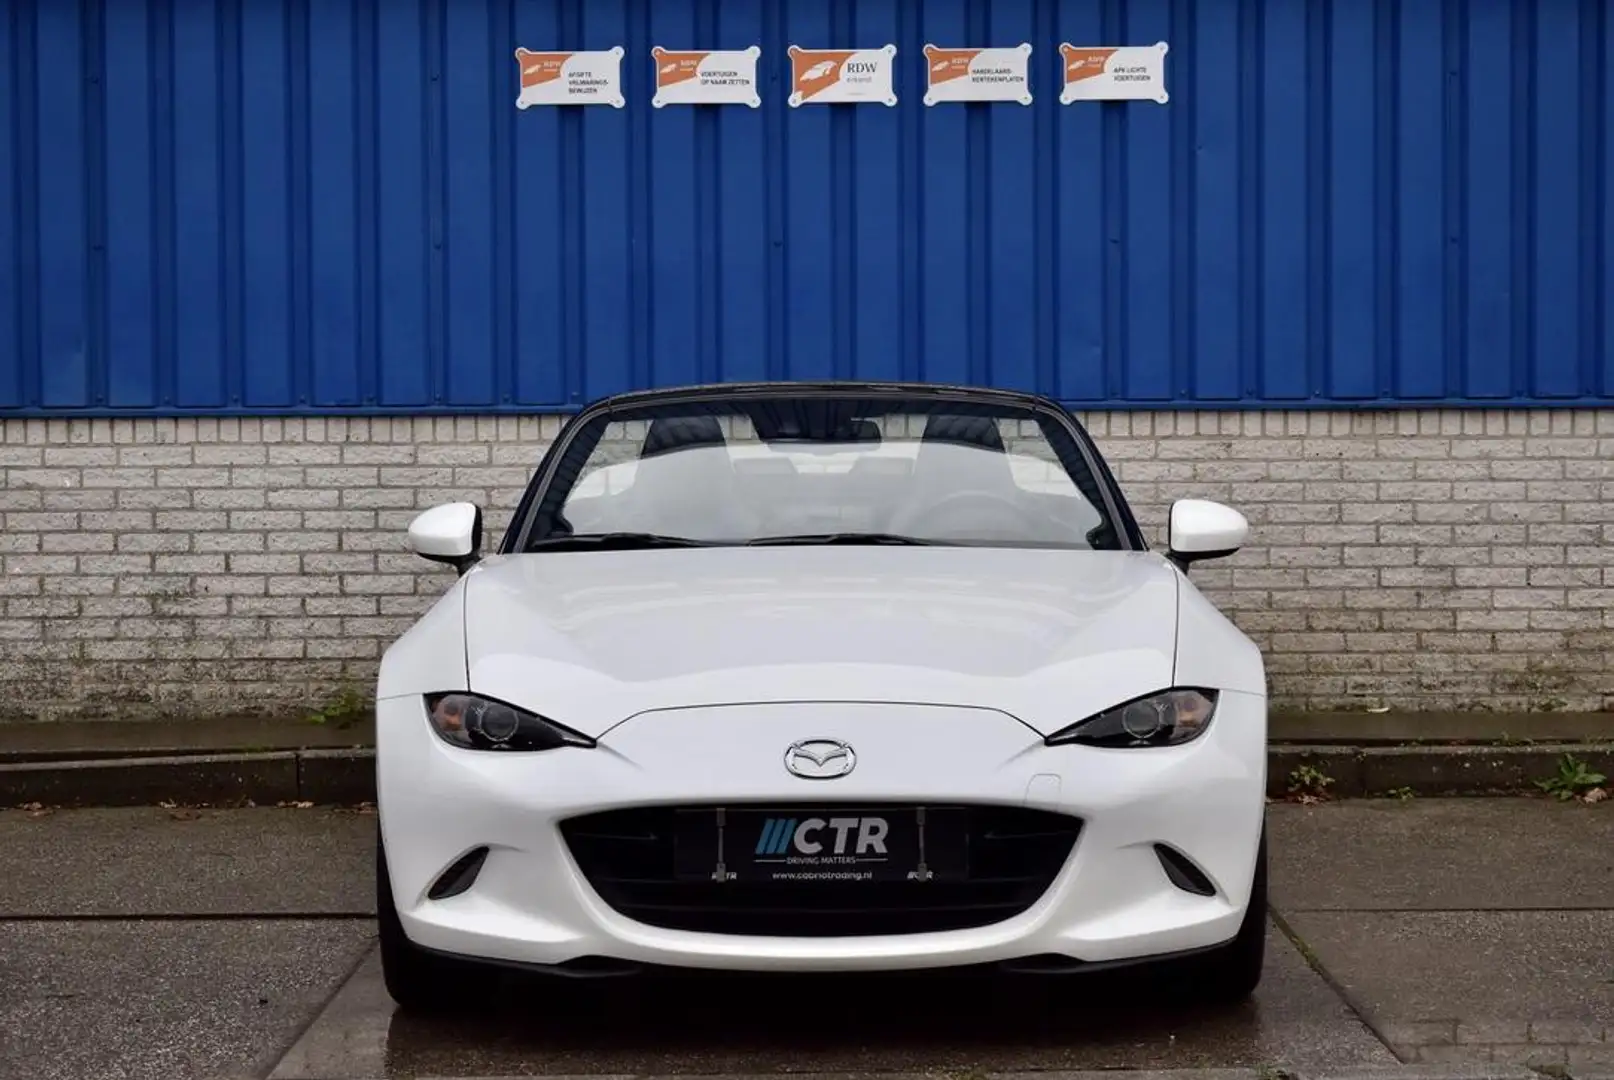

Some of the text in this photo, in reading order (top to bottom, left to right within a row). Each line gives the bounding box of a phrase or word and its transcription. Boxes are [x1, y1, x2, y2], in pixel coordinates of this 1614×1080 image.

[847, 62, 878, 73] RDW
[1113, 66, 1148, 74] APK LICHTE
[972, 75, 1025, 83] KENTEKENPLATEN
[1113, 74, 1152, 82] VOERTUIGEN
[793, 817, 889, 854] CTR
[786, 856, 856, 865] DRIVING MATTERS
